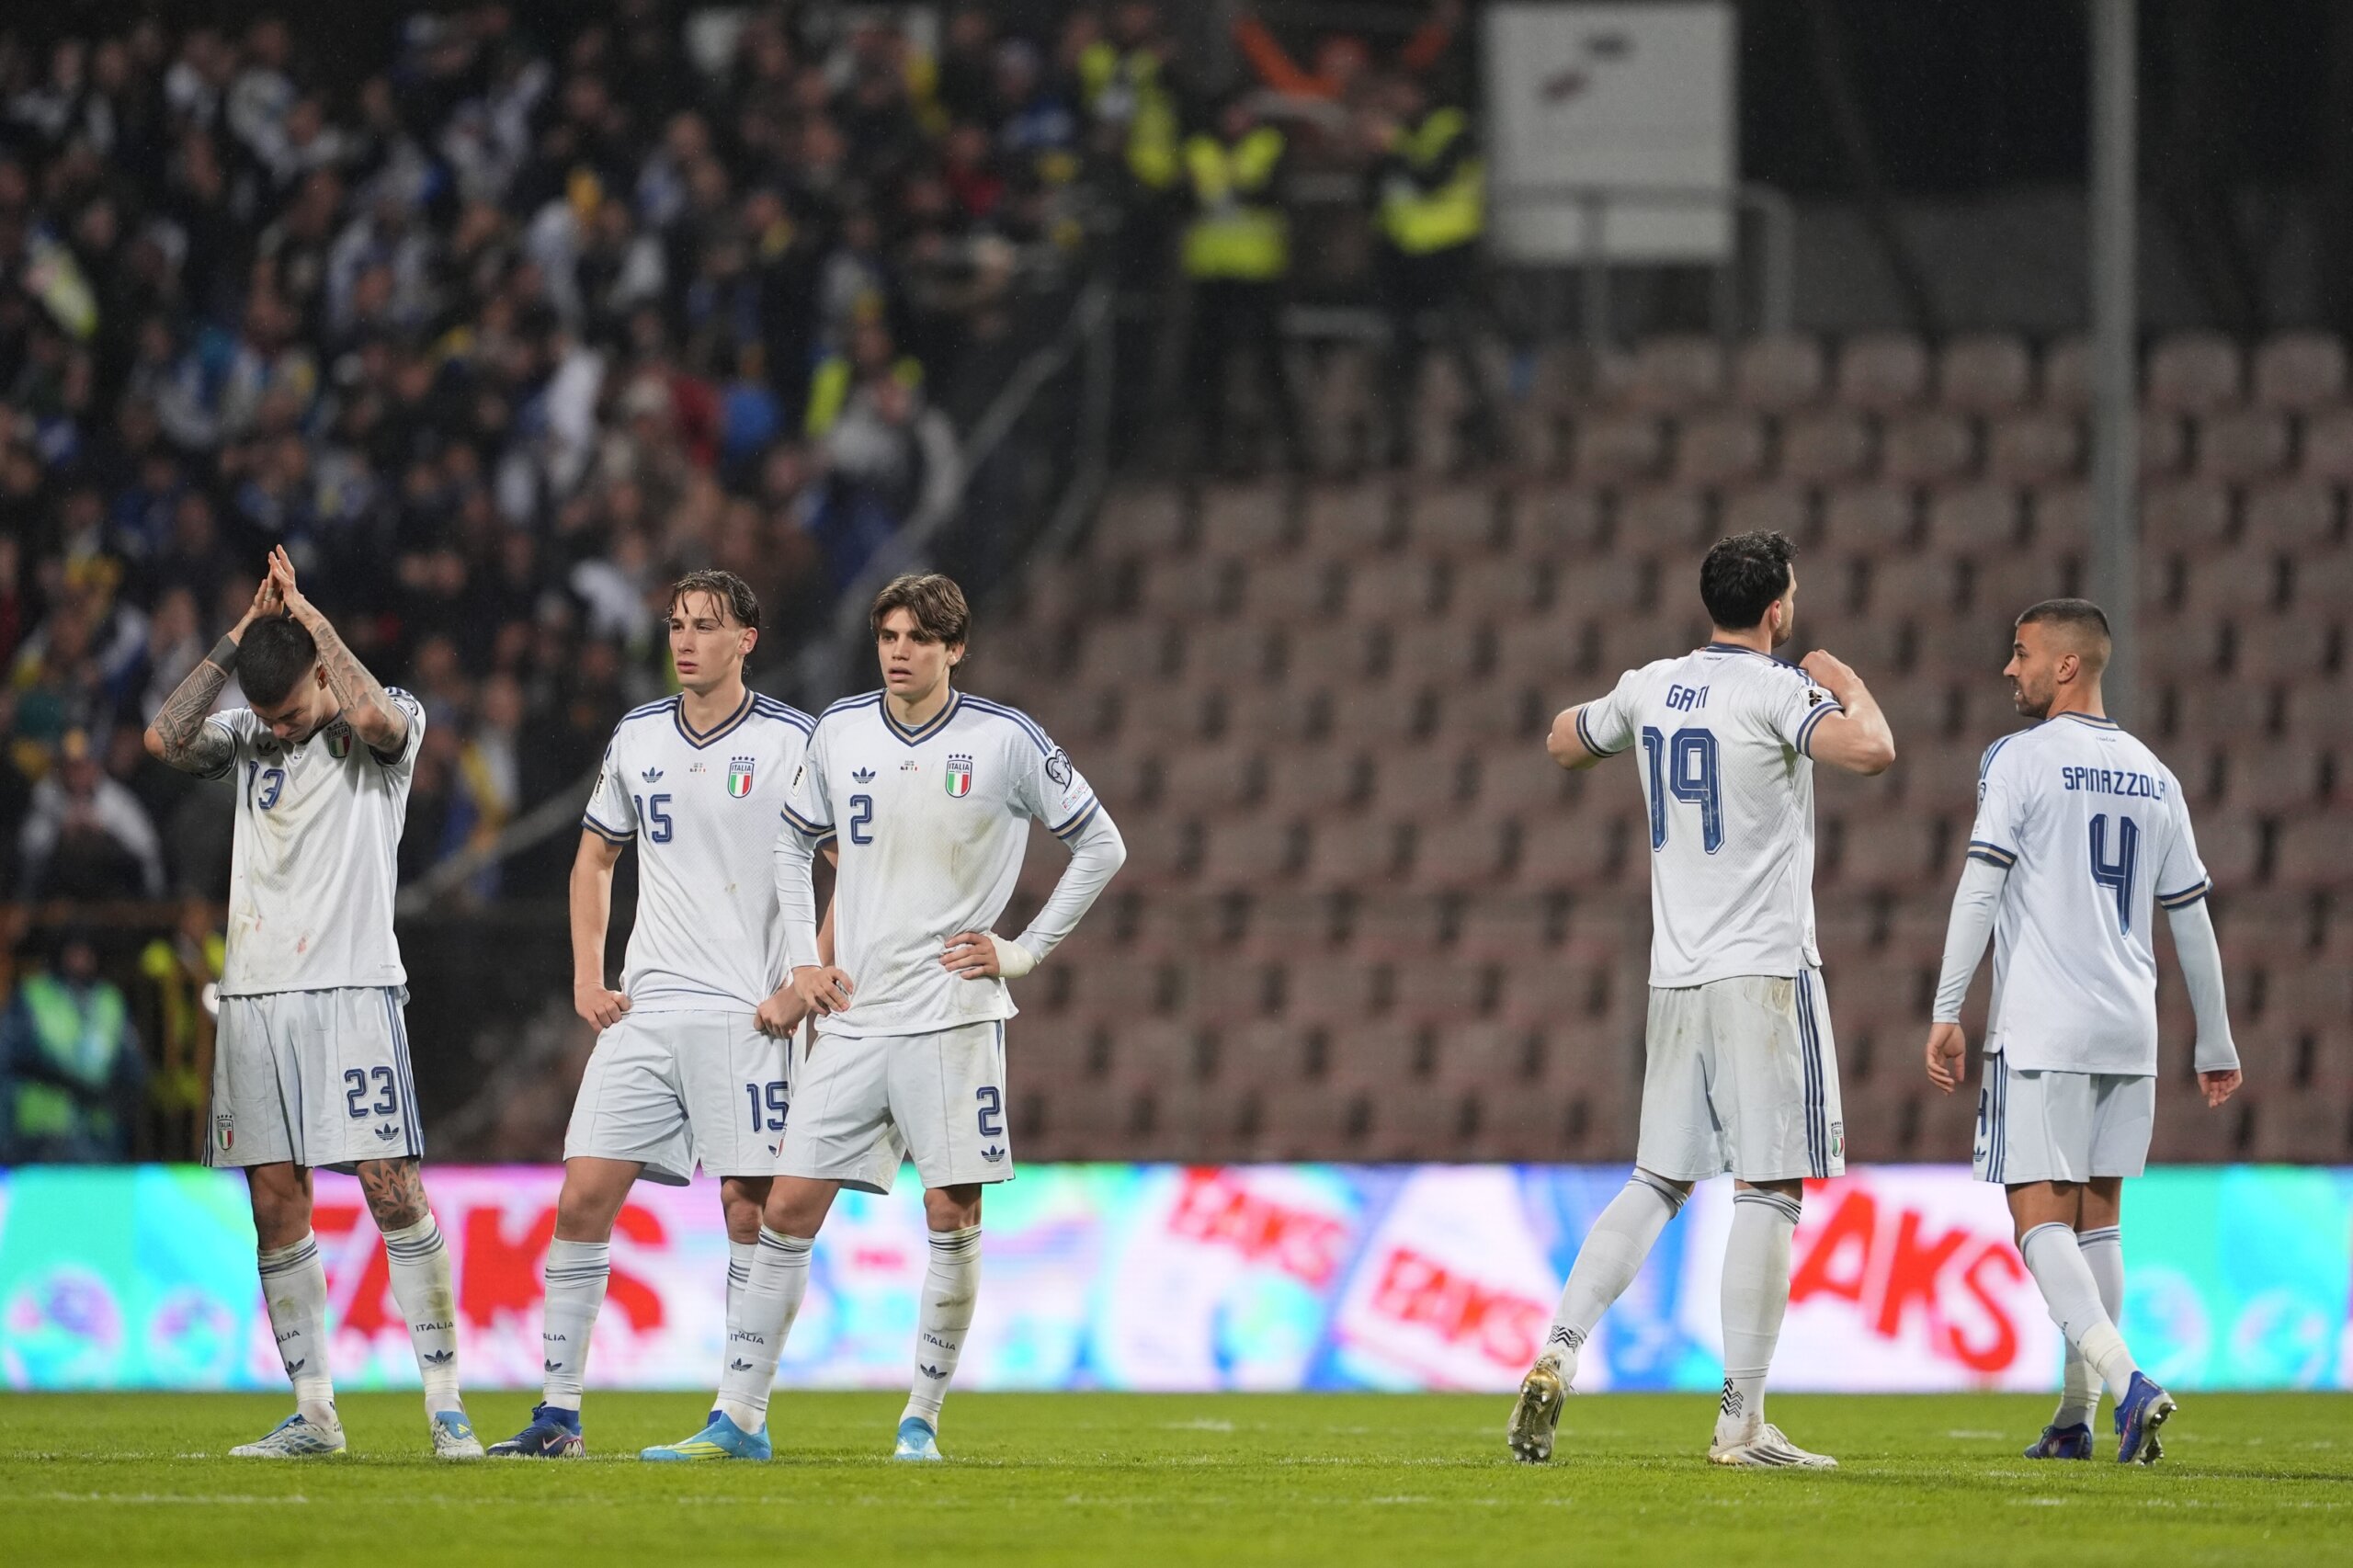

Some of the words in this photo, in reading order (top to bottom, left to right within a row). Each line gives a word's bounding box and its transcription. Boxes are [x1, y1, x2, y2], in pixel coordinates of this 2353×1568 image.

[732, 764, 752, 772] ITALIA
[949, 762, 970, 771] ITALIA
[1643, 726, 1724, 855] 19
[2062, 767, 2165, 803] SPINAZZOLA
[634, 793, 673, 843] 15
[850, 794, 874, 845] 2
[2089, 813, 2140, 939] 4
[345, 1066, 397, 1118] 23
[746, 1080, 790, 1132] 15
[976, 1085, 1003, 1137] 2
[1789, 1177, 2022, 1372] AKS
[276, 1330, 301, 1344] ALIA
[415, 1322, 454, 1332] ITALIA
[543, 1333, 566, 1341] ALIA
[924, 1333, 956, 1350] ITALIA
